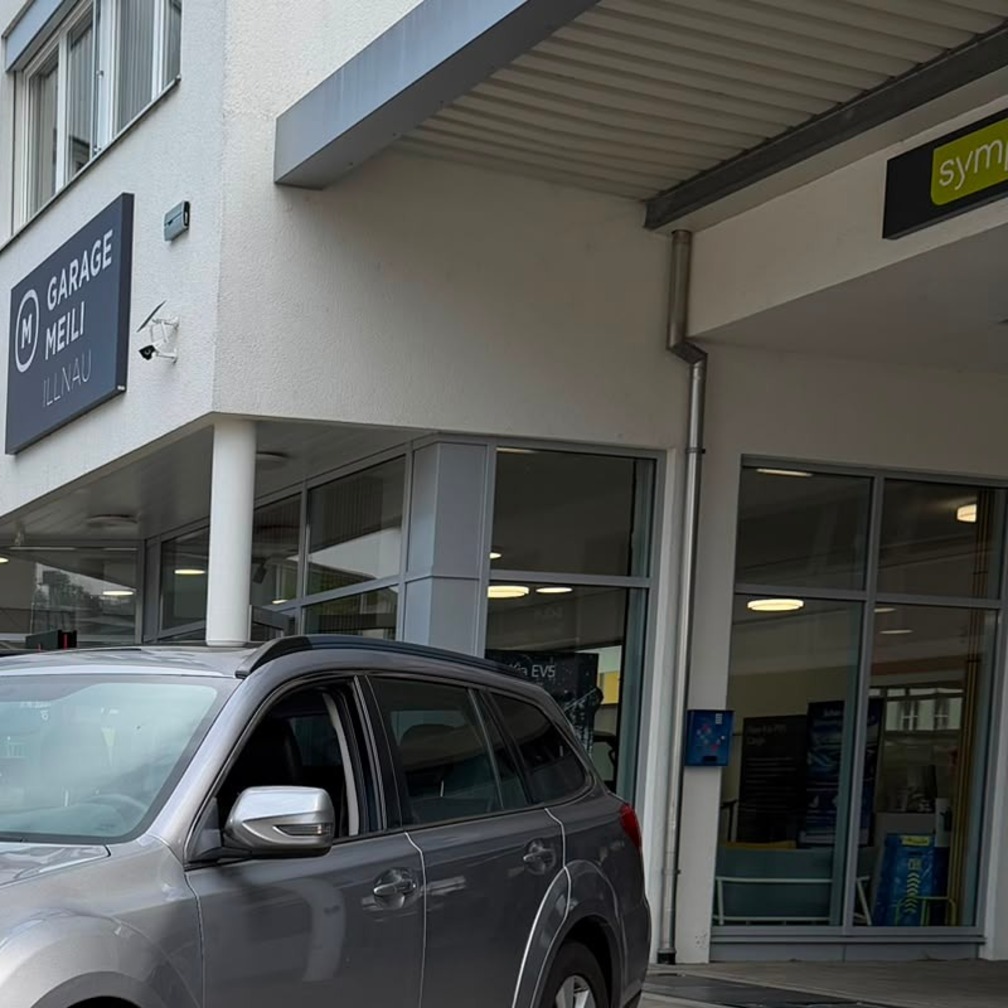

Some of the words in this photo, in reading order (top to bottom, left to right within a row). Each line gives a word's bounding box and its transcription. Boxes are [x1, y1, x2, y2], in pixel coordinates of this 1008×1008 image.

[47, 229, 113, 311] GARAGE
[21, 313, 33, 349] M
[45, 301, 85, 361] MEILI
[43, 348, 92, 408] ILLNAU
[531, 664, 556, 678] EV5
